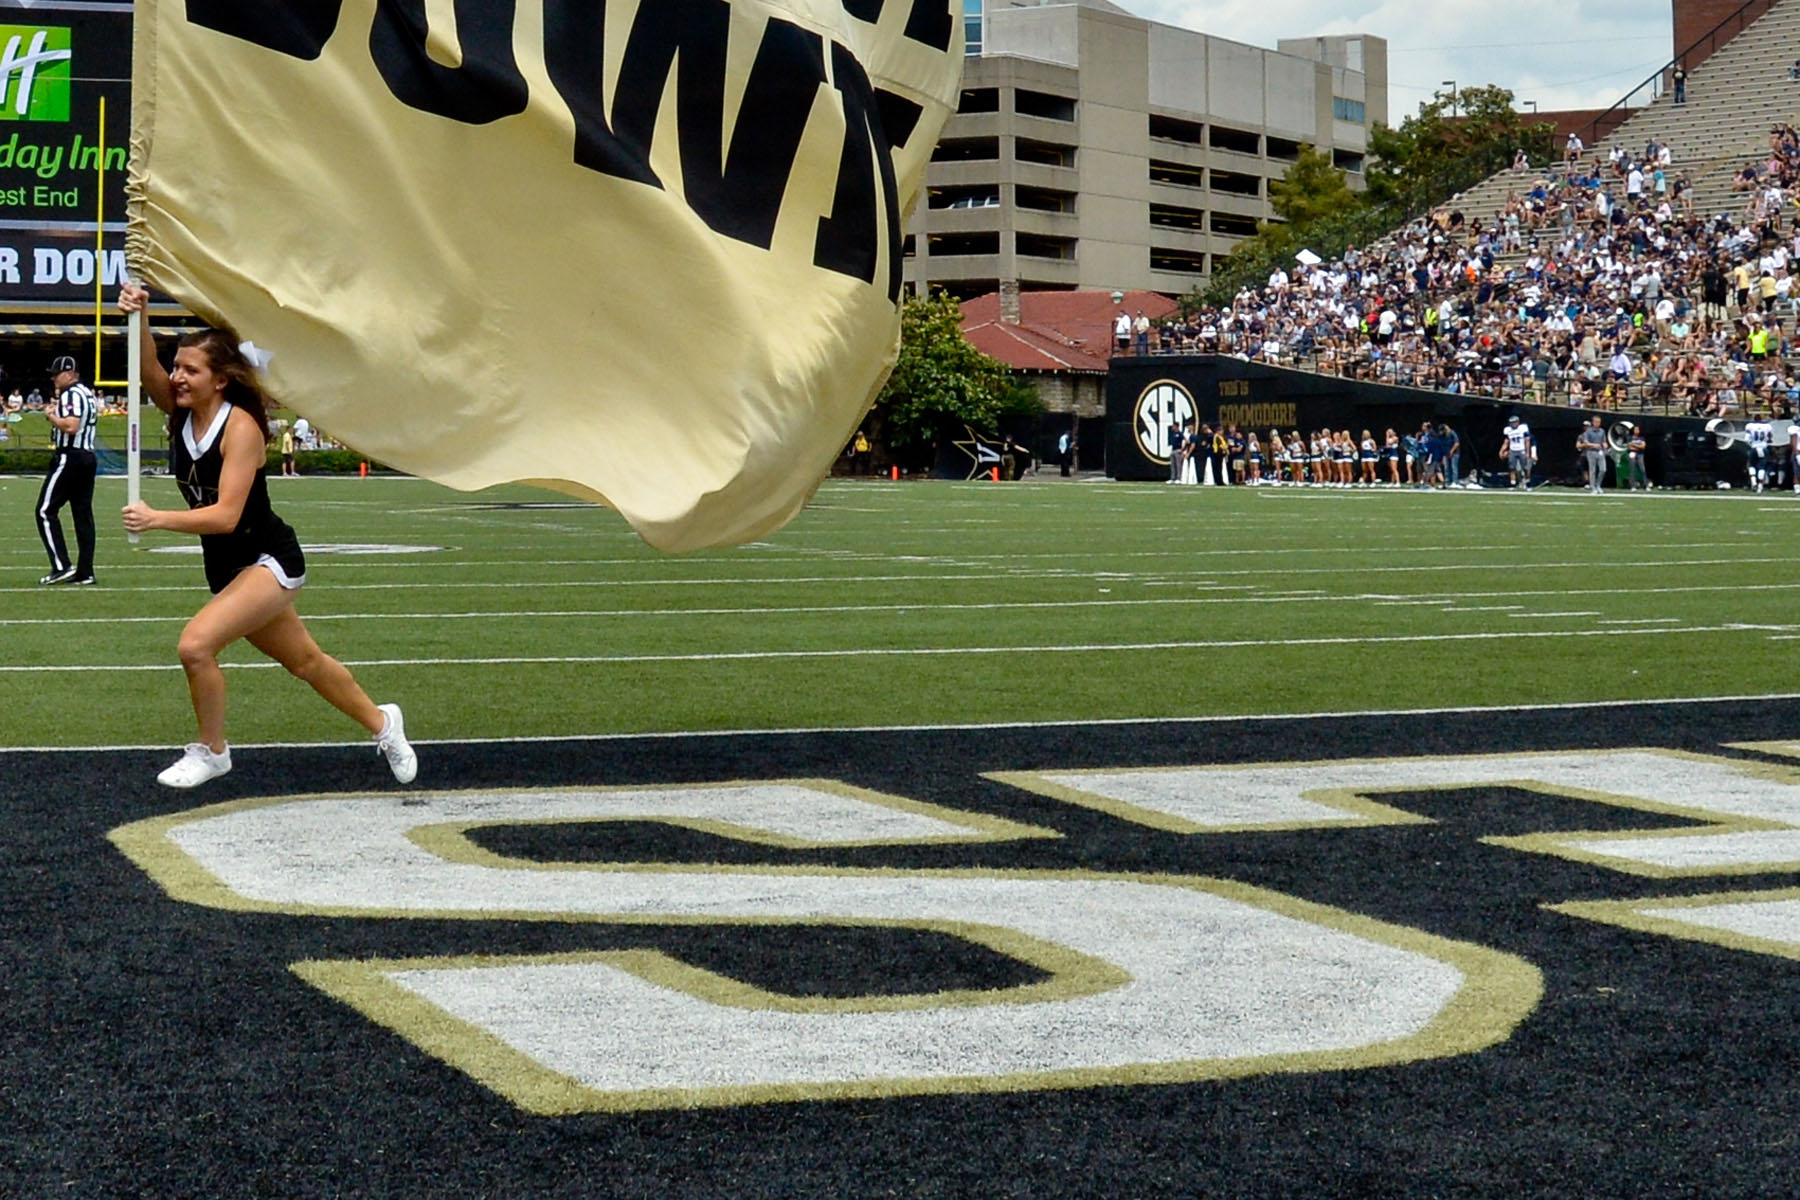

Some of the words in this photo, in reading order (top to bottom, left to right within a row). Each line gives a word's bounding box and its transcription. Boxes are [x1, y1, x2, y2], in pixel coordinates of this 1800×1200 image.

[68, 134, 126, 171] Inn
[33, 186, 78, 207] End
[33, 248, 128, 285] DOW
